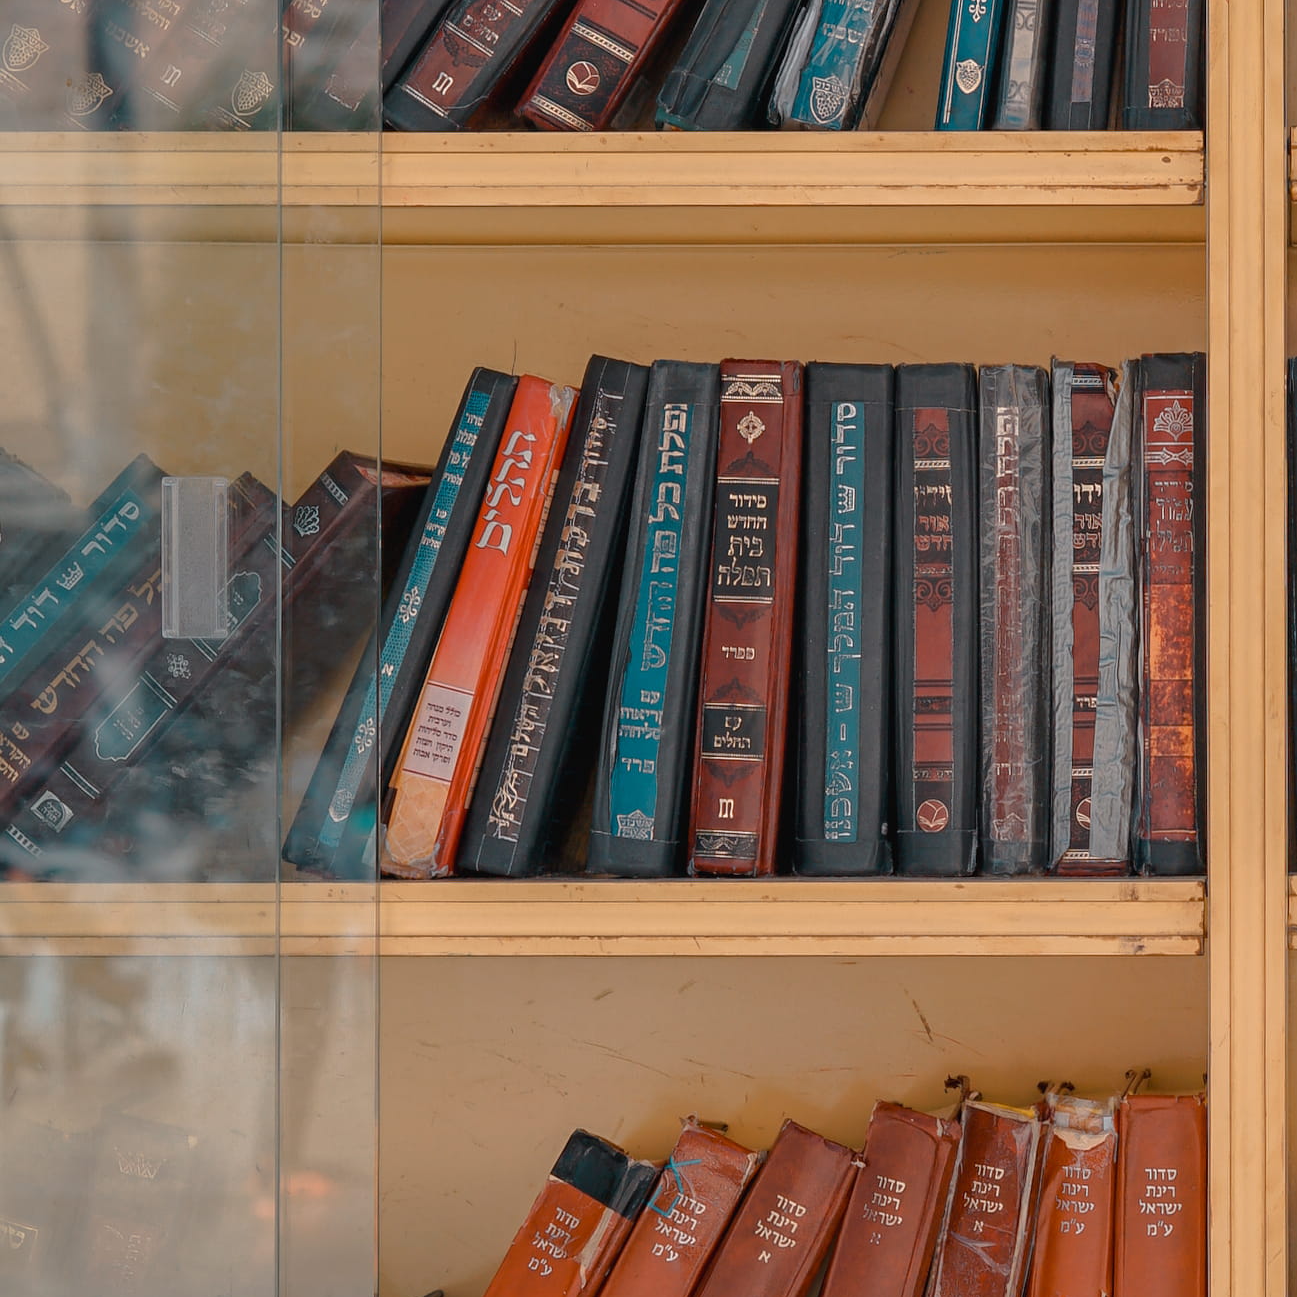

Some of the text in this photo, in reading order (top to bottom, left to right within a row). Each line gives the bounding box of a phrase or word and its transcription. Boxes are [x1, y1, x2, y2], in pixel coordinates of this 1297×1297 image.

[974, 1163, 1004, 1181] סדור
[1061, 1165, 1092, 1181] סדור
[1144, 1167, 1178, 1181] סדור
[971, 1180, 1001, 1197] רינת
[1062, 1181, 1090, 1198] רינת
[1146, 1183, 1176, 1199] רינת
[676, 1193, 707, 1216] סדור
[775, 1195, 807, 1218] סדור
[963, 1194, 1004, 1213] ישראל
[1055, 1196, 1095, 1213] ישראל
[1139, 1198, 1183, 1215] ישראל
[668, 1208, 698, 1231] רינת
[766, 1210, 799, 1233] רינת
[654, 1218, 697, 1247] ישראל
[754, 1223, 797, 1249] ישראל
[758, 1249, 772, 1263] א
